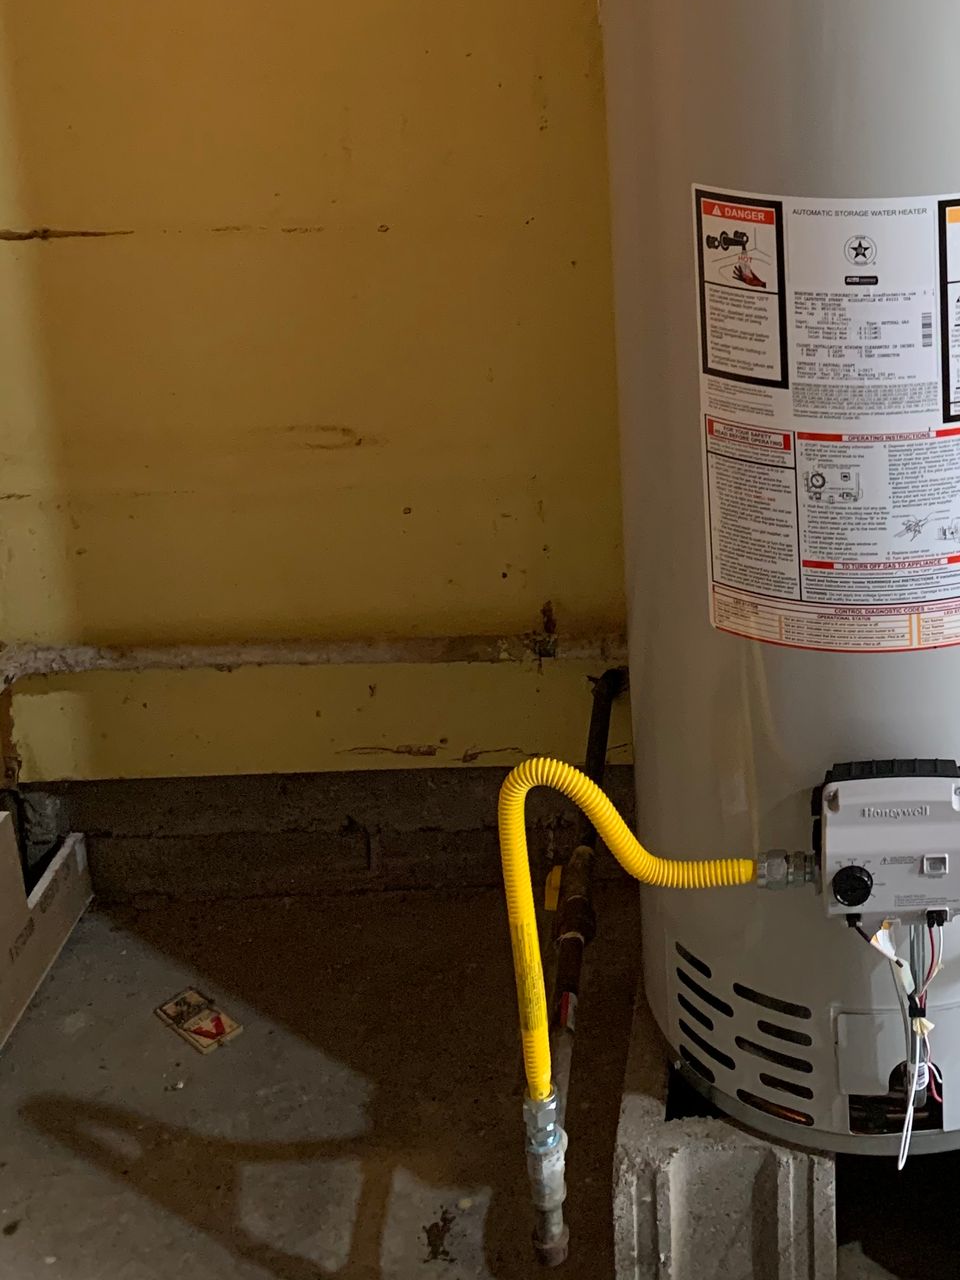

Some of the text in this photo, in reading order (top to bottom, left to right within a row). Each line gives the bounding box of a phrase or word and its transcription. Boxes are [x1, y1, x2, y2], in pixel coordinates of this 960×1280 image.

[725, 208, 765, 222] DANGER
[792, 208, 927, 217] AUTOMATIC STORAGE WATER HEATER
[848, 434, 884, 442] OPERATING
[908, 559, 941, 568] APPLIANCE
[860, 806, 930, 819] Honeywell
